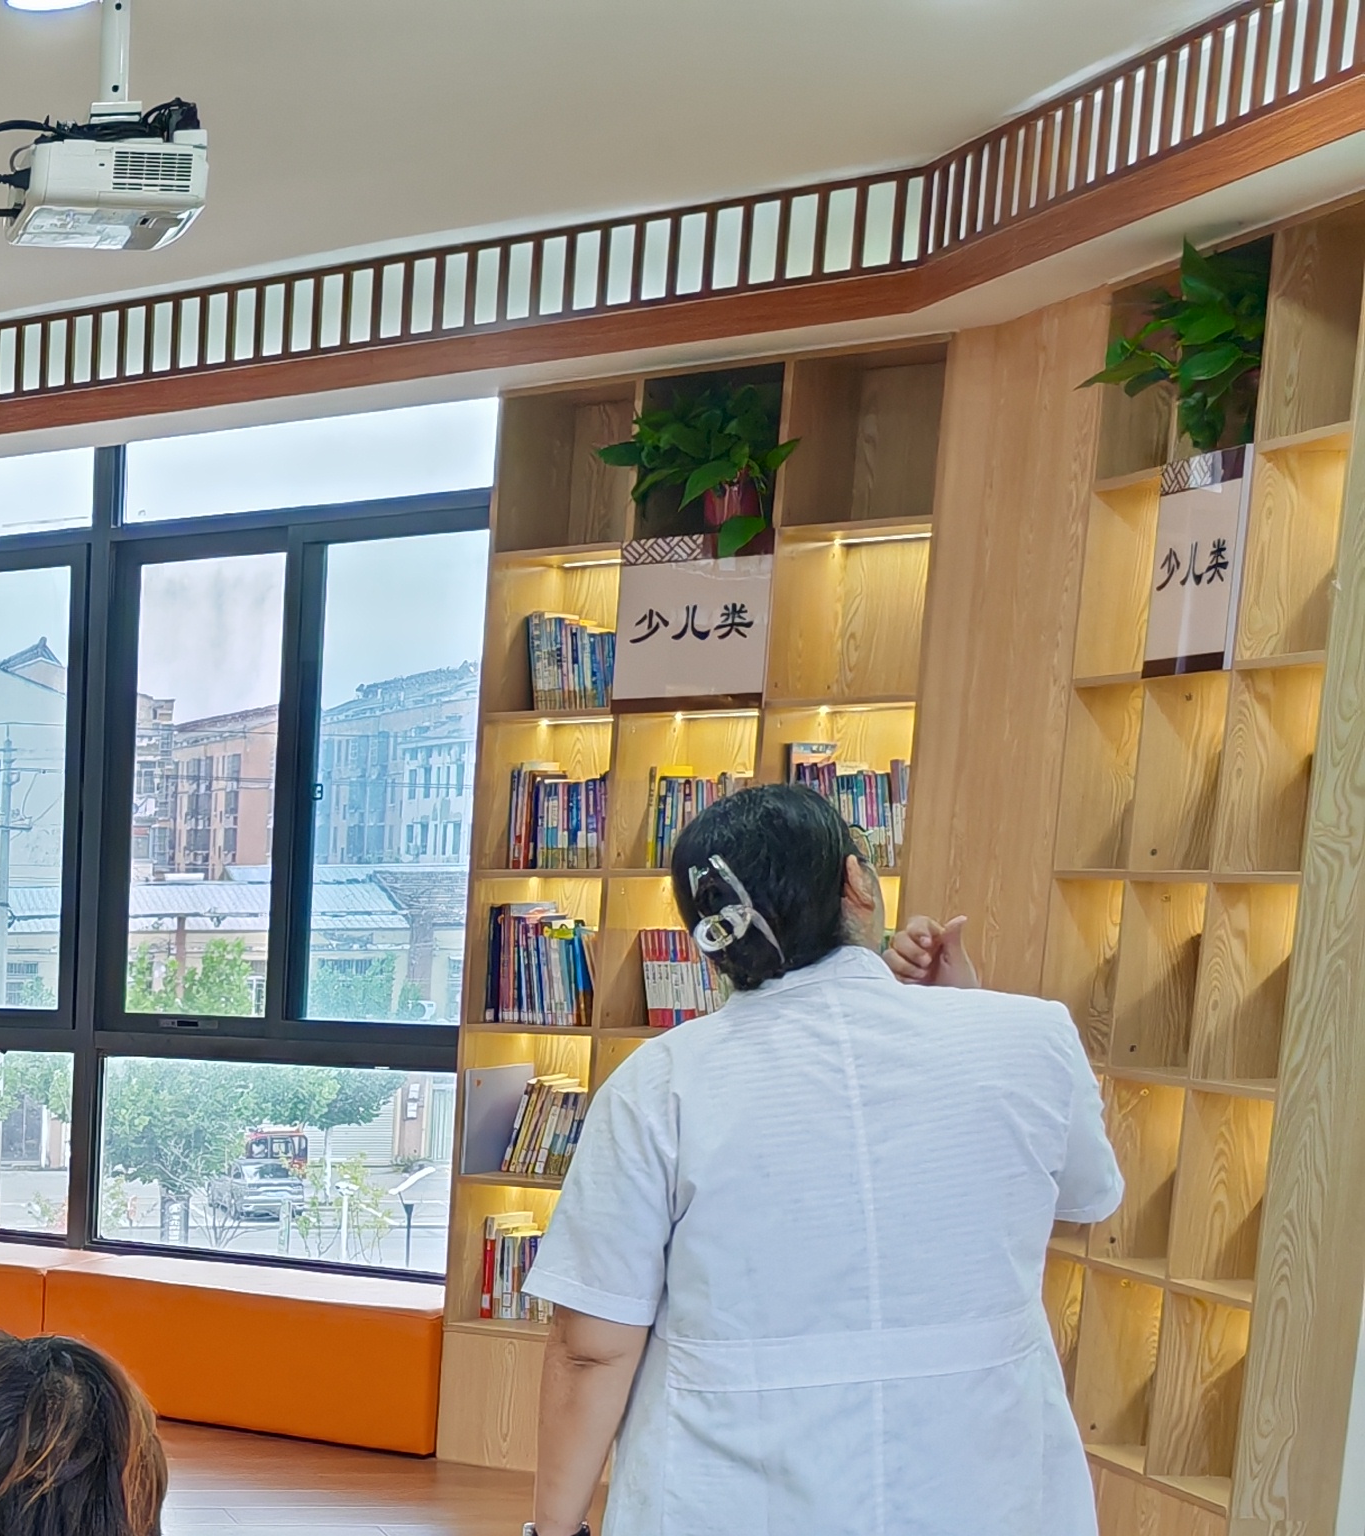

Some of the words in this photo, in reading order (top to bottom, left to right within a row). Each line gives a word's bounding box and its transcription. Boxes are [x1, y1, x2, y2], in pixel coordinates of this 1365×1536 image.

[1155, 538, 1229, 592] 少儿类
[629, 602, 754, 644] 少儿类
